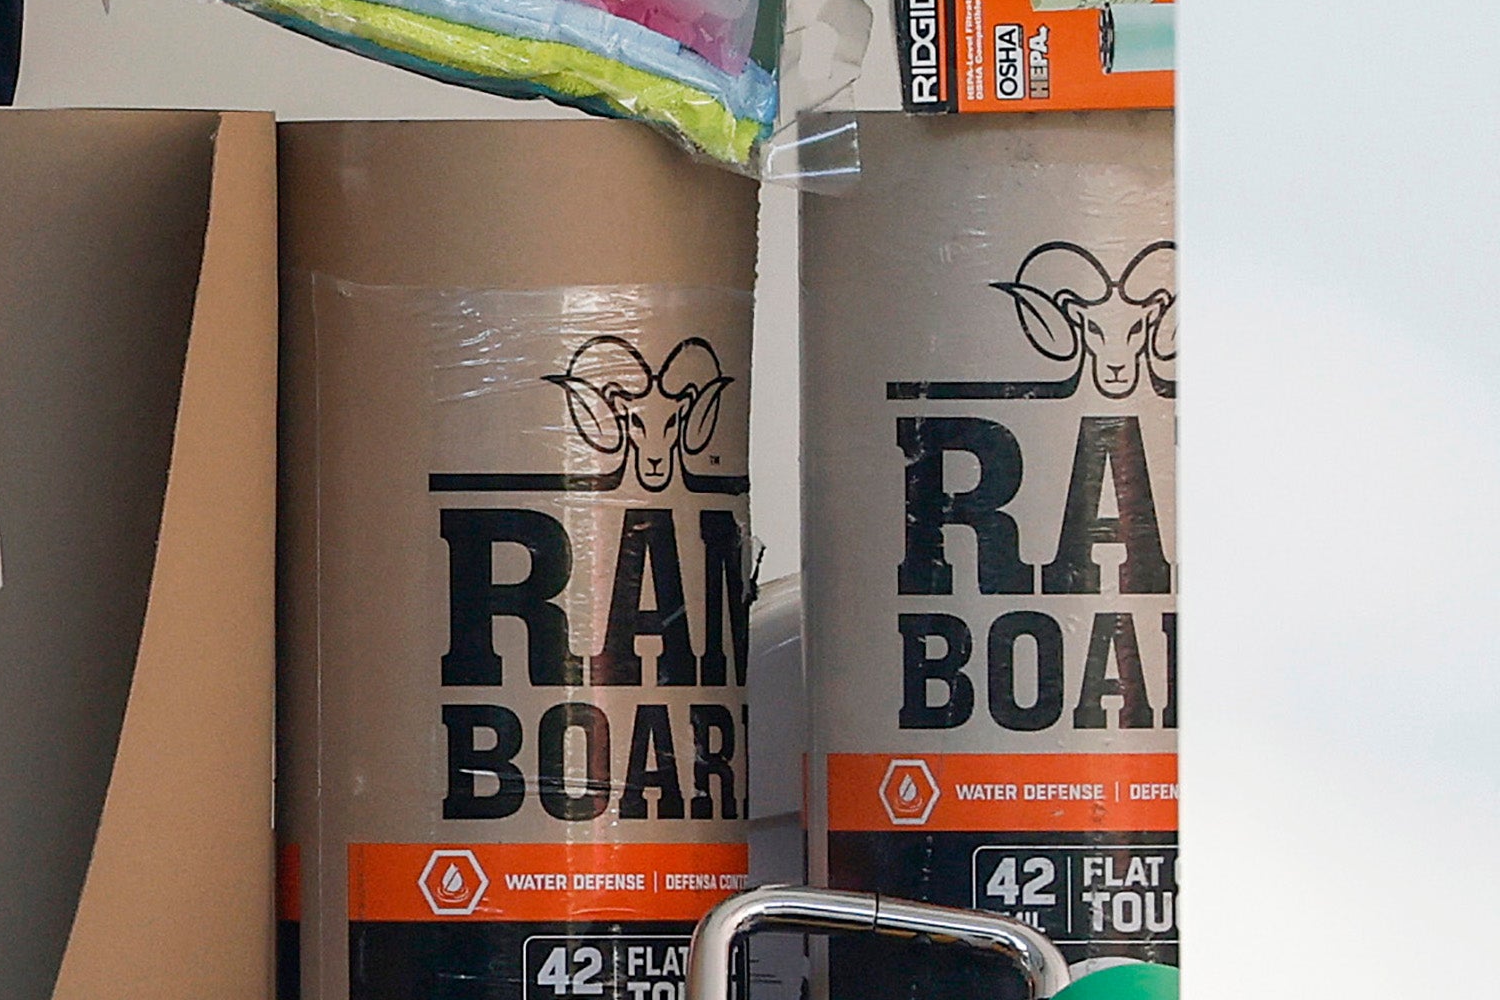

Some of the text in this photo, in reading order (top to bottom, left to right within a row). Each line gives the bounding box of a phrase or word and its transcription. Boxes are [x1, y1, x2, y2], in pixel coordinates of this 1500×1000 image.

[998, 28, 1018, 96] OSHA
[1029, 36, 1049, 98] HEPA
[896, 416, 1179, 595] RA
[442, 702, 749, 820] BOAR
[955, 784, 1180, 800] WATER DEFENSE DEFEN
[505, 874, 557, 890] WATER
[573, 874, 645, 890] DEFENSE
[665, 873, 718, 890] DEFENSA
[986, 857, 1056, 905] 42
[1083, 856, 1165, 887] FLAT
[1082, 891, 1179, 933] TOU
[537, 947, 604, 995] 42
